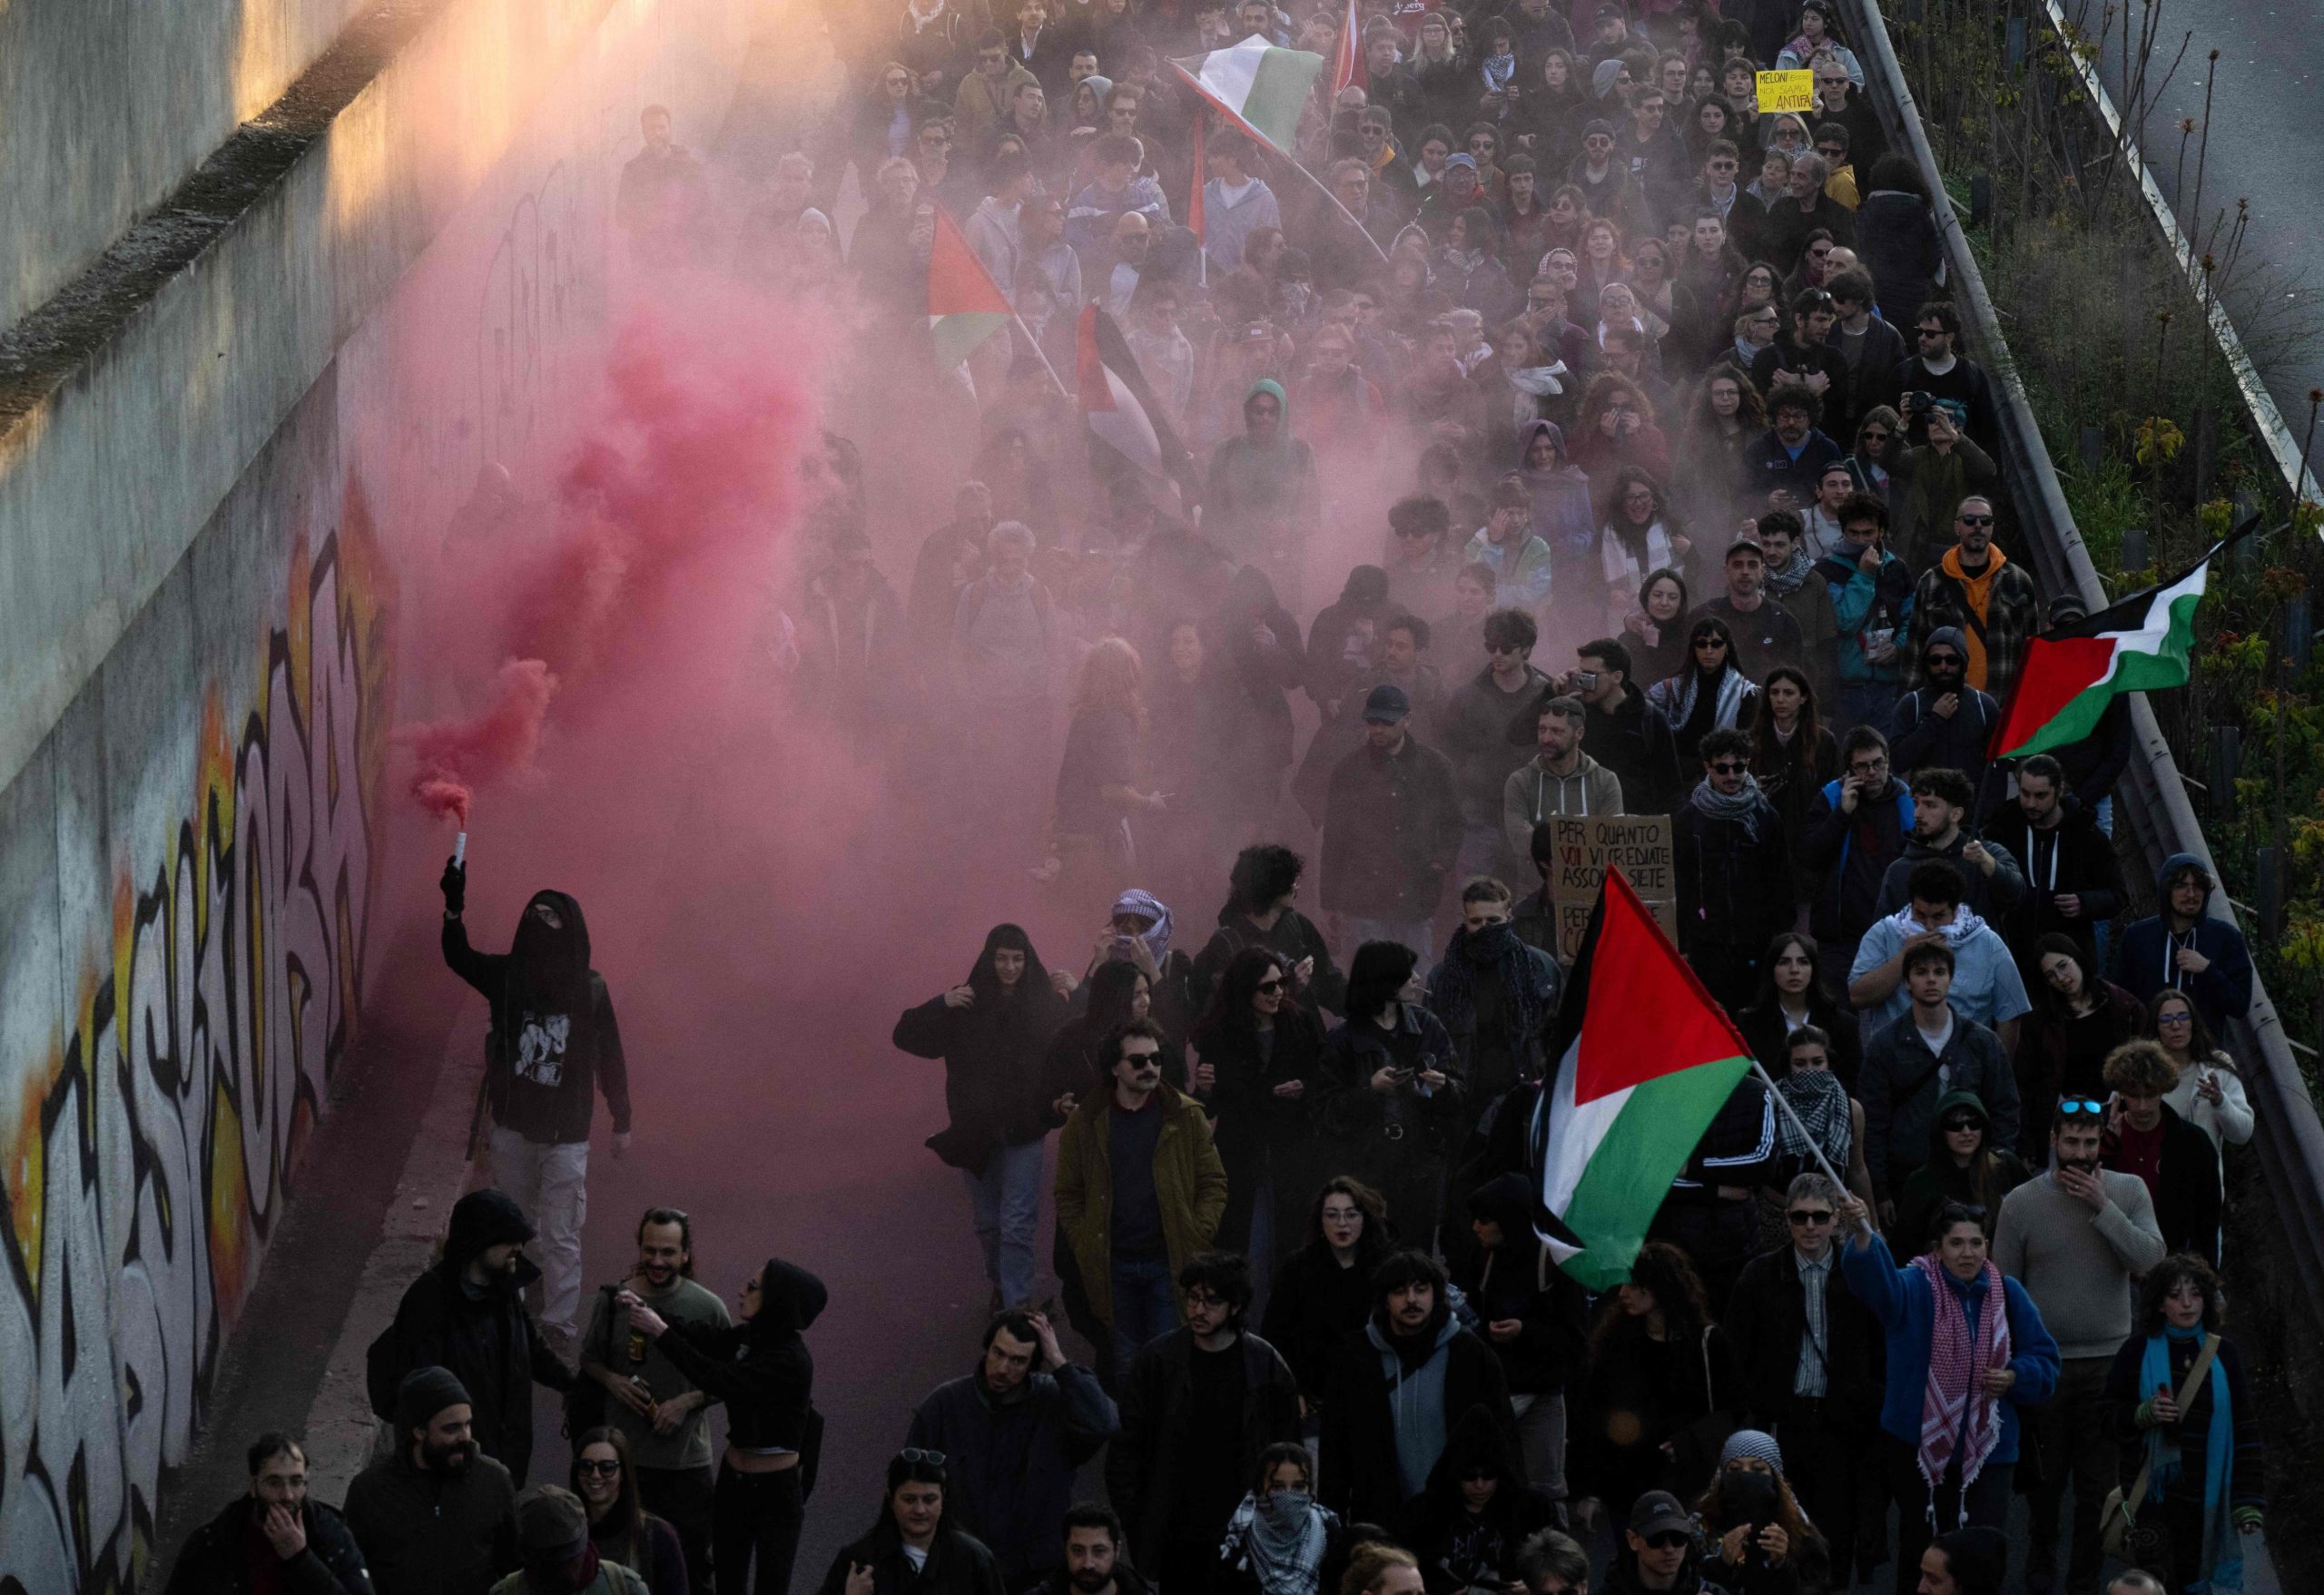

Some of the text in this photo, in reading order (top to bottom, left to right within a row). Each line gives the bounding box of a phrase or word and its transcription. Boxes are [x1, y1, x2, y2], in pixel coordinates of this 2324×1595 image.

[1759, 72, 1788, 84] MELONI
[1779, 84, 1807, 94] SIAMO
[1558, 820, 1659, 846] PER QUANTO
[1559, 846, 1670, 866] VOI VI CREDIATE
[1629, 868, 1666, 888] SIETE
